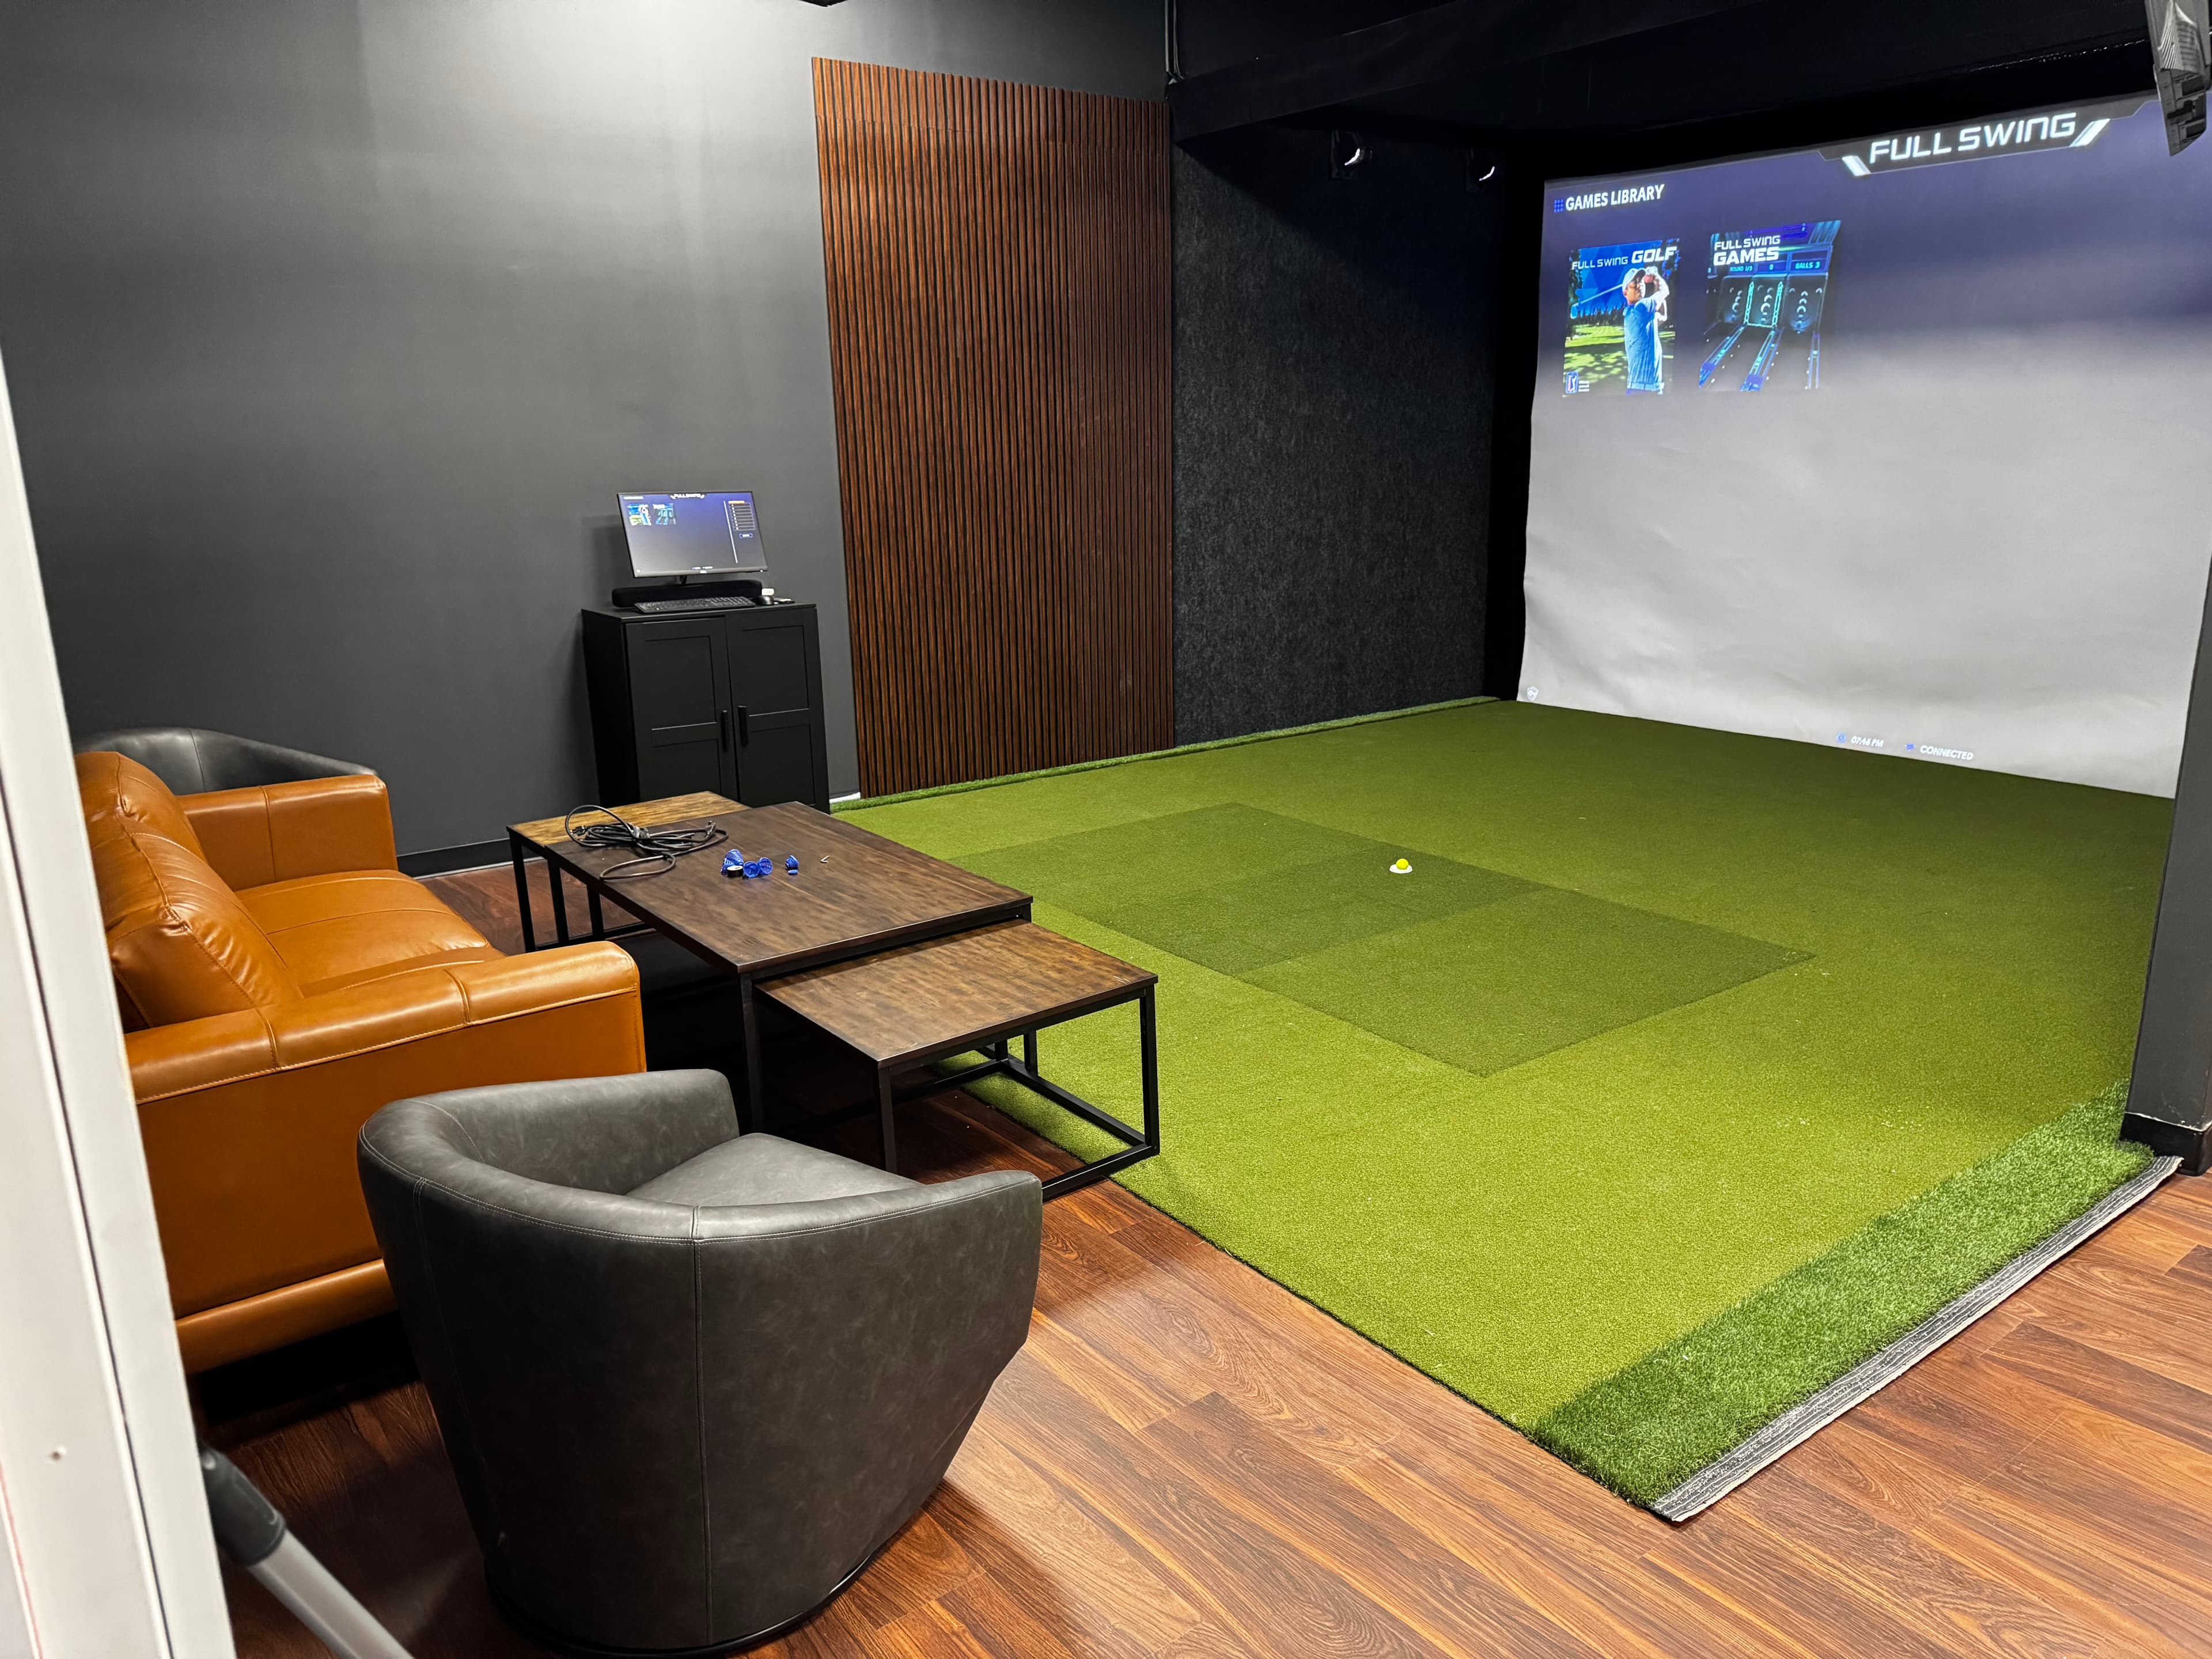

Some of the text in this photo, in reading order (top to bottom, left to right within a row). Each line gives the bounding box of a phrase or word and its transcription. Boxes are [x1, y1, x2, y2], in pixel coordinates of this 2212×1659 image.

[1870, 112, 2077, 164] FULL SWING
[1565, 184, 1665, 211] GAMES LIBRARY
[1714, 235, 1781, 251] FULL SWING
[1571, 246, 1677, 270] FULL SWING GOLF
[1713, 246, 1779, 266] GAMES
[1871, 738, 1884, 747] PM
[1921, 745, 1974, 760] CONNECTED
